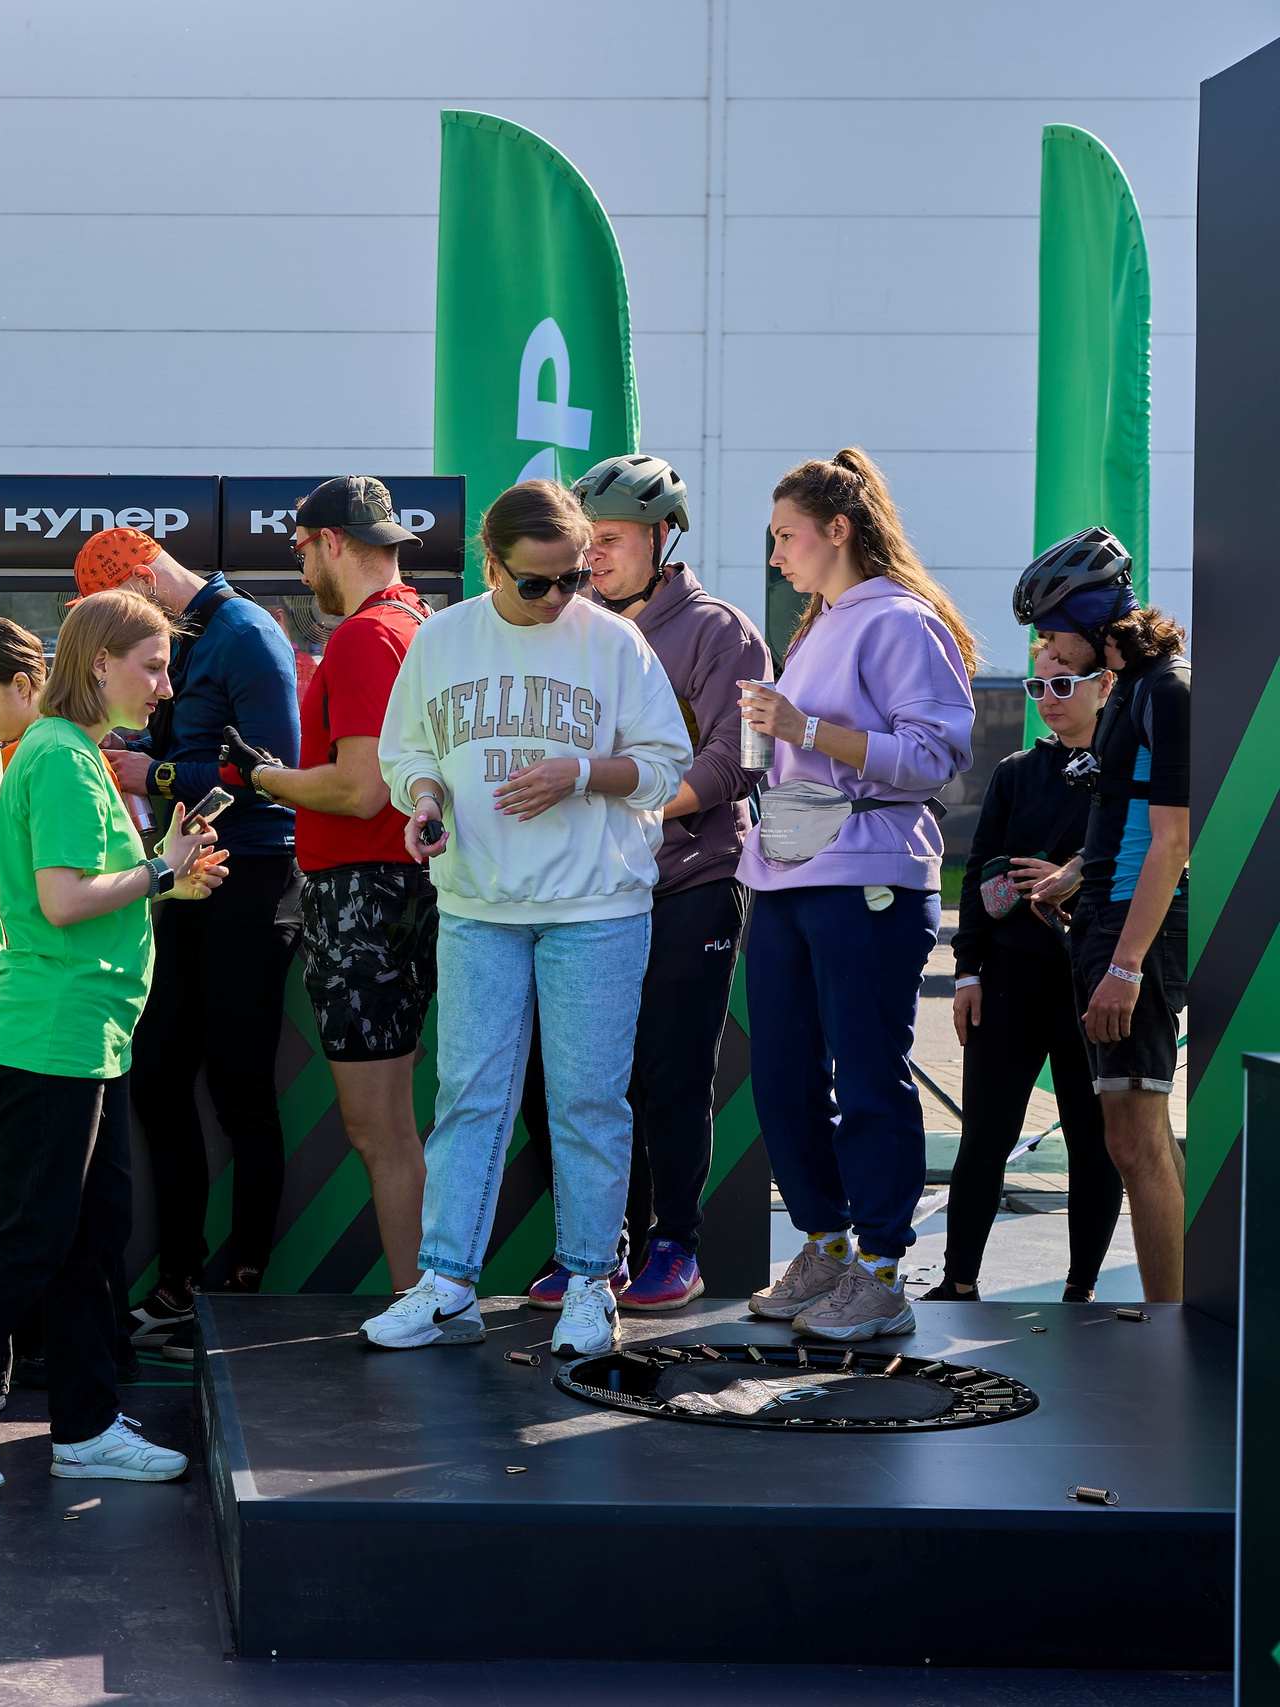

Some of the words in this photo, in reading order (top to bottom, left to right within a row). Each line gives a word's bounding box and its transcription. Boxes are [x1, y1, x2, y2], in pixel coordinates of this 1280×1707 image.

[4, 507, 190, 538] купер
[100, 556, 113, 569] AMS
[107, 567, 122, 580] DAM
[426, 675, 602, 761] WELLNES
[704, 939, 732, 952] FILA
